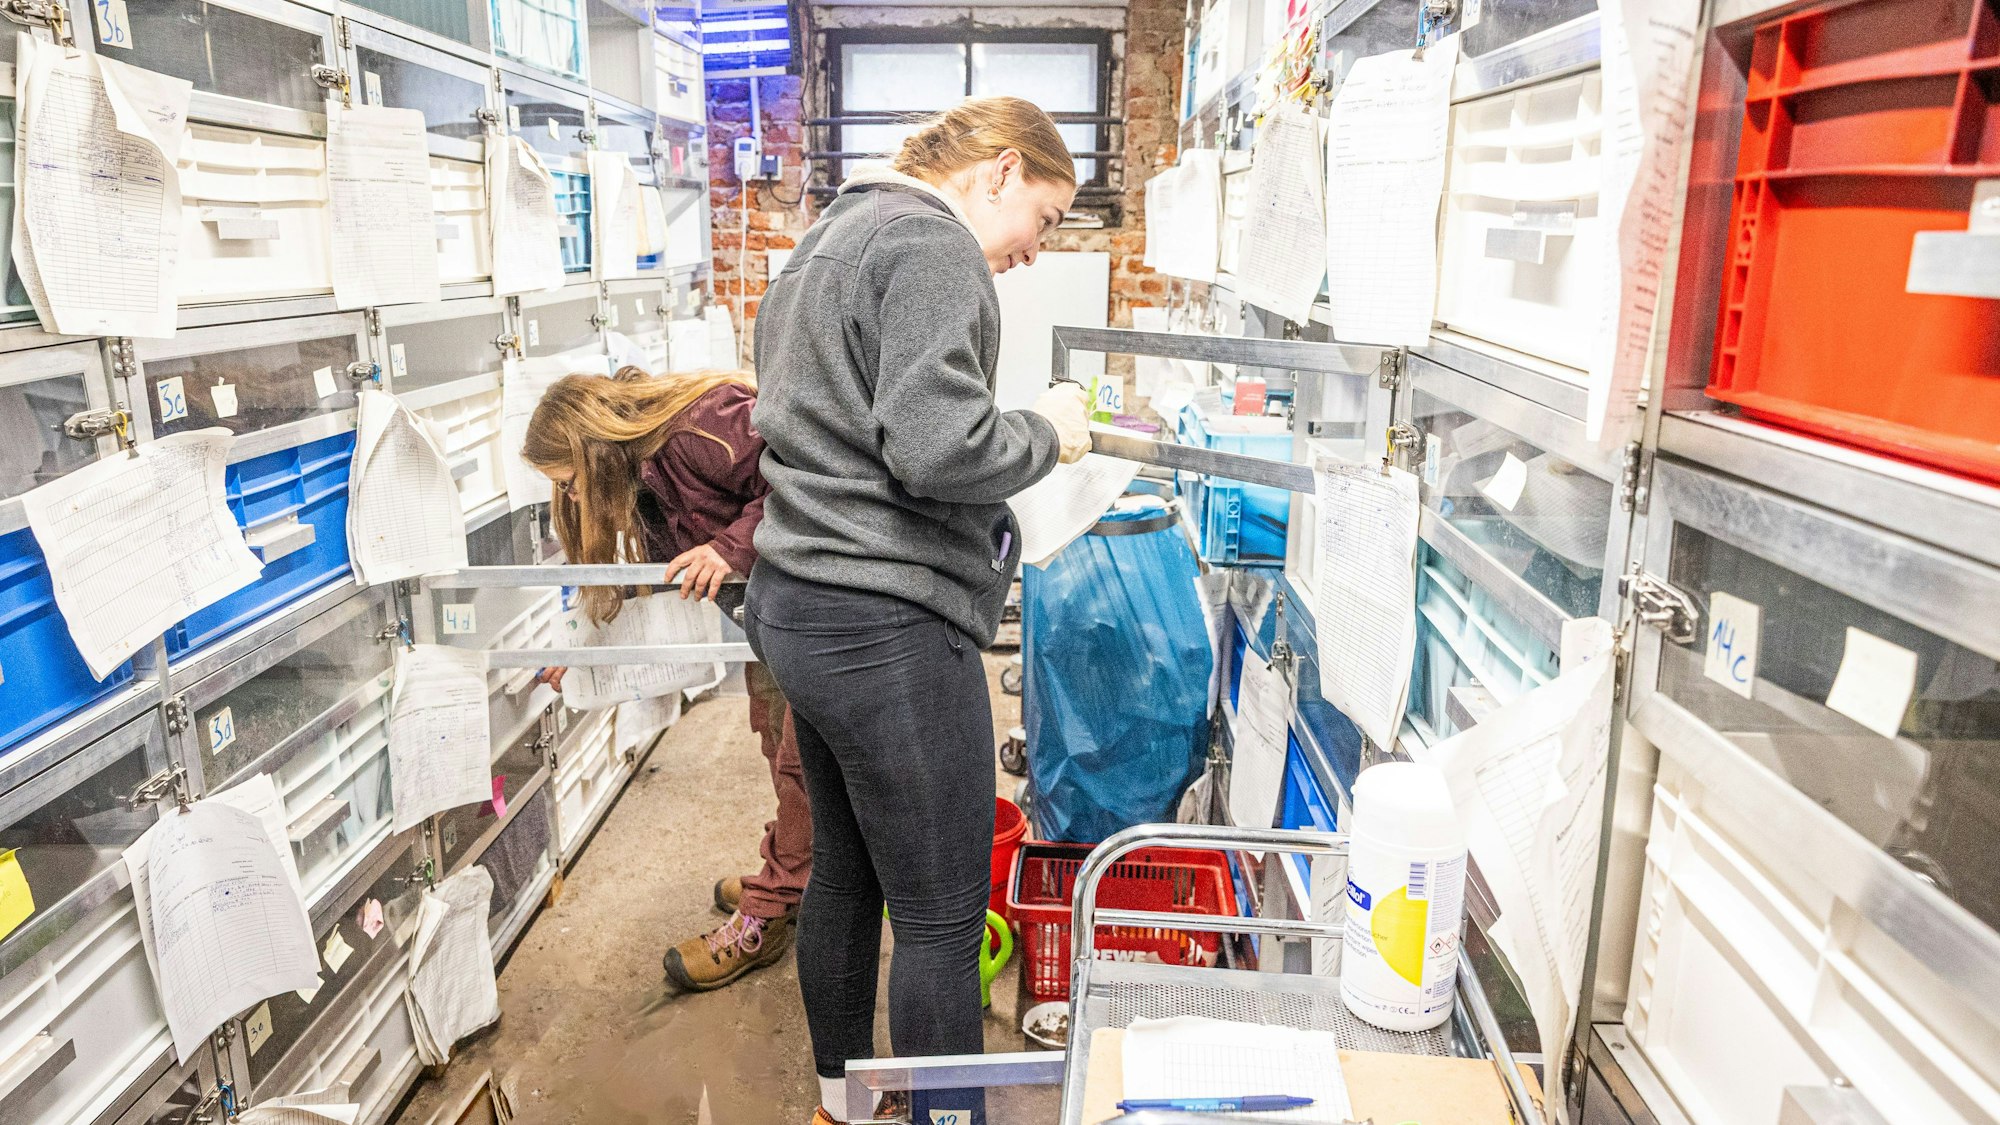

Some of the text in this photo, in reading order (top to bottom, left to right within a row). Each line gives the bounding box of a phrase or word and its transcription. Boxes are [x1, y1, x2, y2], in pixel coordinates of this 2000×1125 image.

[160, 383, 185, 418] 3c
[1098, 384, 1122, 410] 12c
[1712, 618, 1747, 683] 14c
[213, 716, 232, 749] 3d
